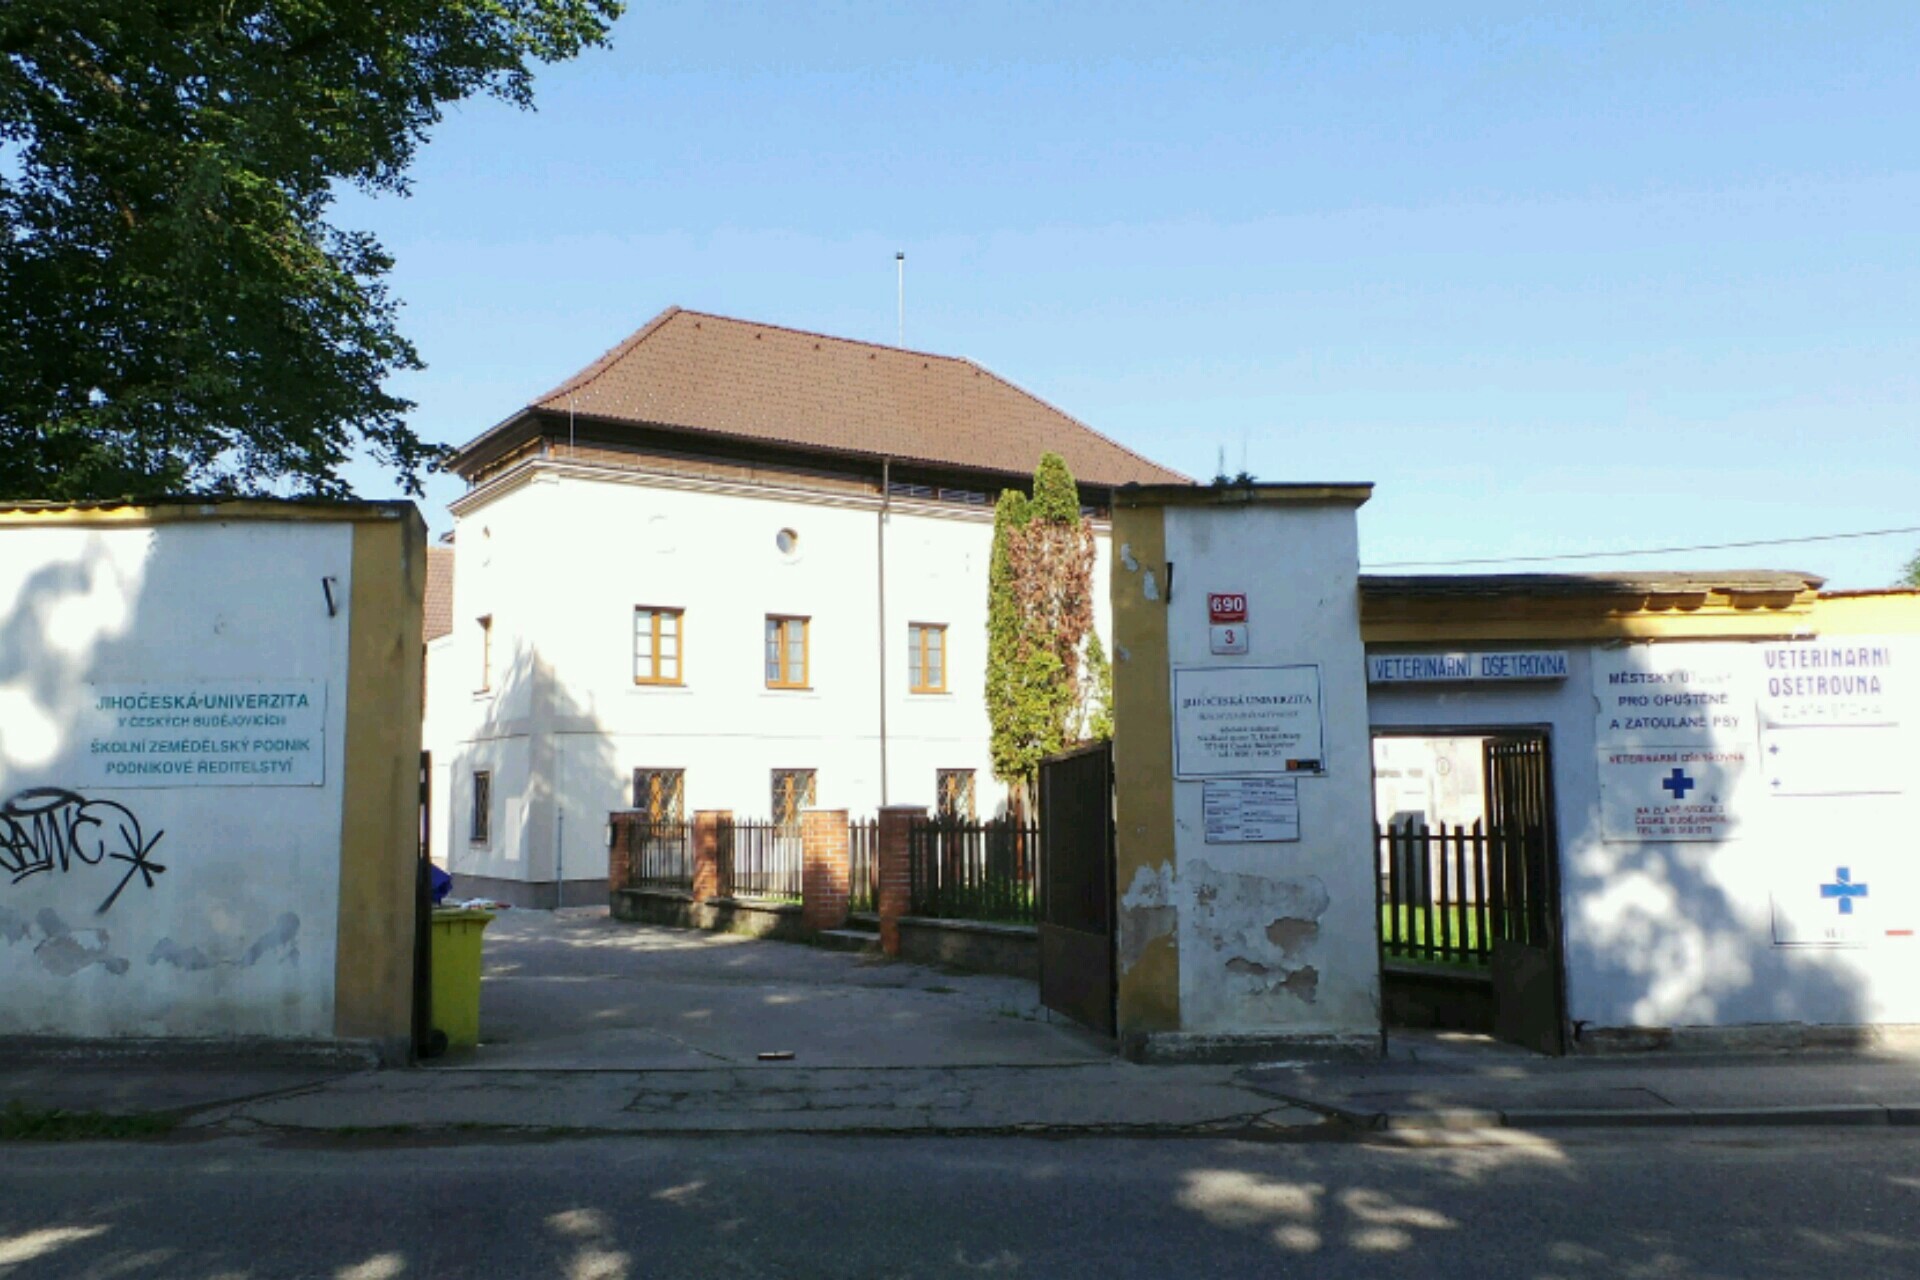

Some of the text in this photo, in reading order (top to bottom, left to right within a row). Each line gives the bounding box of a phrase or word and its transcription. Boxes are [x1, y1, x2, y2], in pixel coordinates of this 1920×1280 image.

[1213, 597, 1243, 612] 690
[1225, 629, 1235, 645] 3
[95, 690, 309, 710] JIHOČESKÁ UNIVERZITA
[1618, 696, 1649, 707] PRO
[1609, 719, 1619, 730] A
[91, 736, 310, 754] ŠKOLNÍ ZEMĚDĚLSKÝ PODNIK
[105, 756, 294, 774] PODNIKOVÉ ŘEDITELSTVÍ
